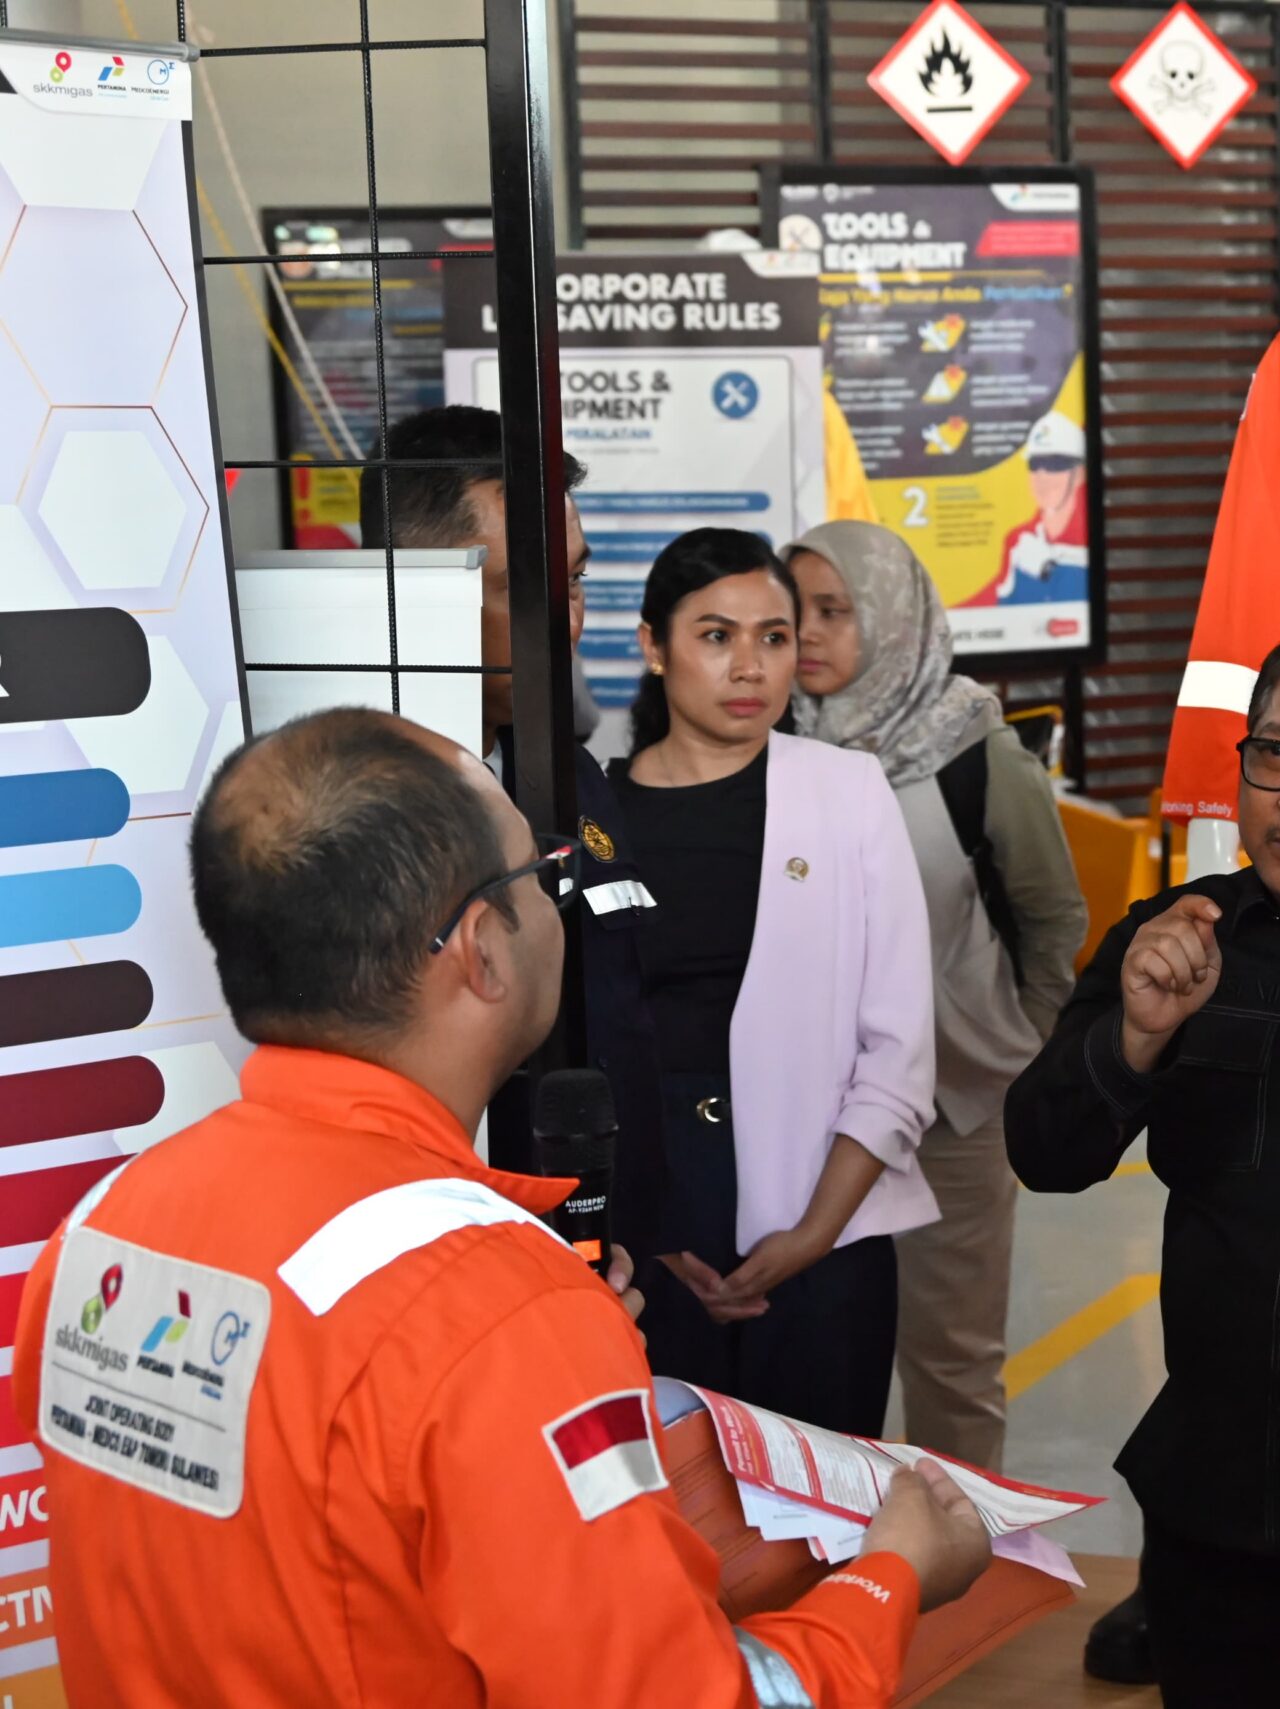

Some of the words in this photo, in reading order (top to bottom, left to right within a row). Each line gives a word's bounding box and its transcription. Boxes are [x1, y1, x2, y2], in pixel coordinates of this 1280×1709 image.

[33, 83, 93, 98] skkmigas
[822, 212, 908, 239] TOOLS
[824, 243, 967, 269] EQUIPMENT
[556, 273, 726, 301] ORPORATE
[683, 302, 781, 331] RULES
[560, 371, 642, 393] OOLS
[650, 371, 671, 393] &
[563, 399, 662, 421] IPMENT
[904, 487, 928, 527] 2
[1198, 801, 1232, 818] Safely
[565, 1196, 606, 1207] AUDERPRO
[56, 1325, 129, 1371] skkmigas
[85, 1395, 110, 1417] JOINT
[110, 1403, 154, 1435] OPERATING
[153, 1419, 175, 1443] BODY
